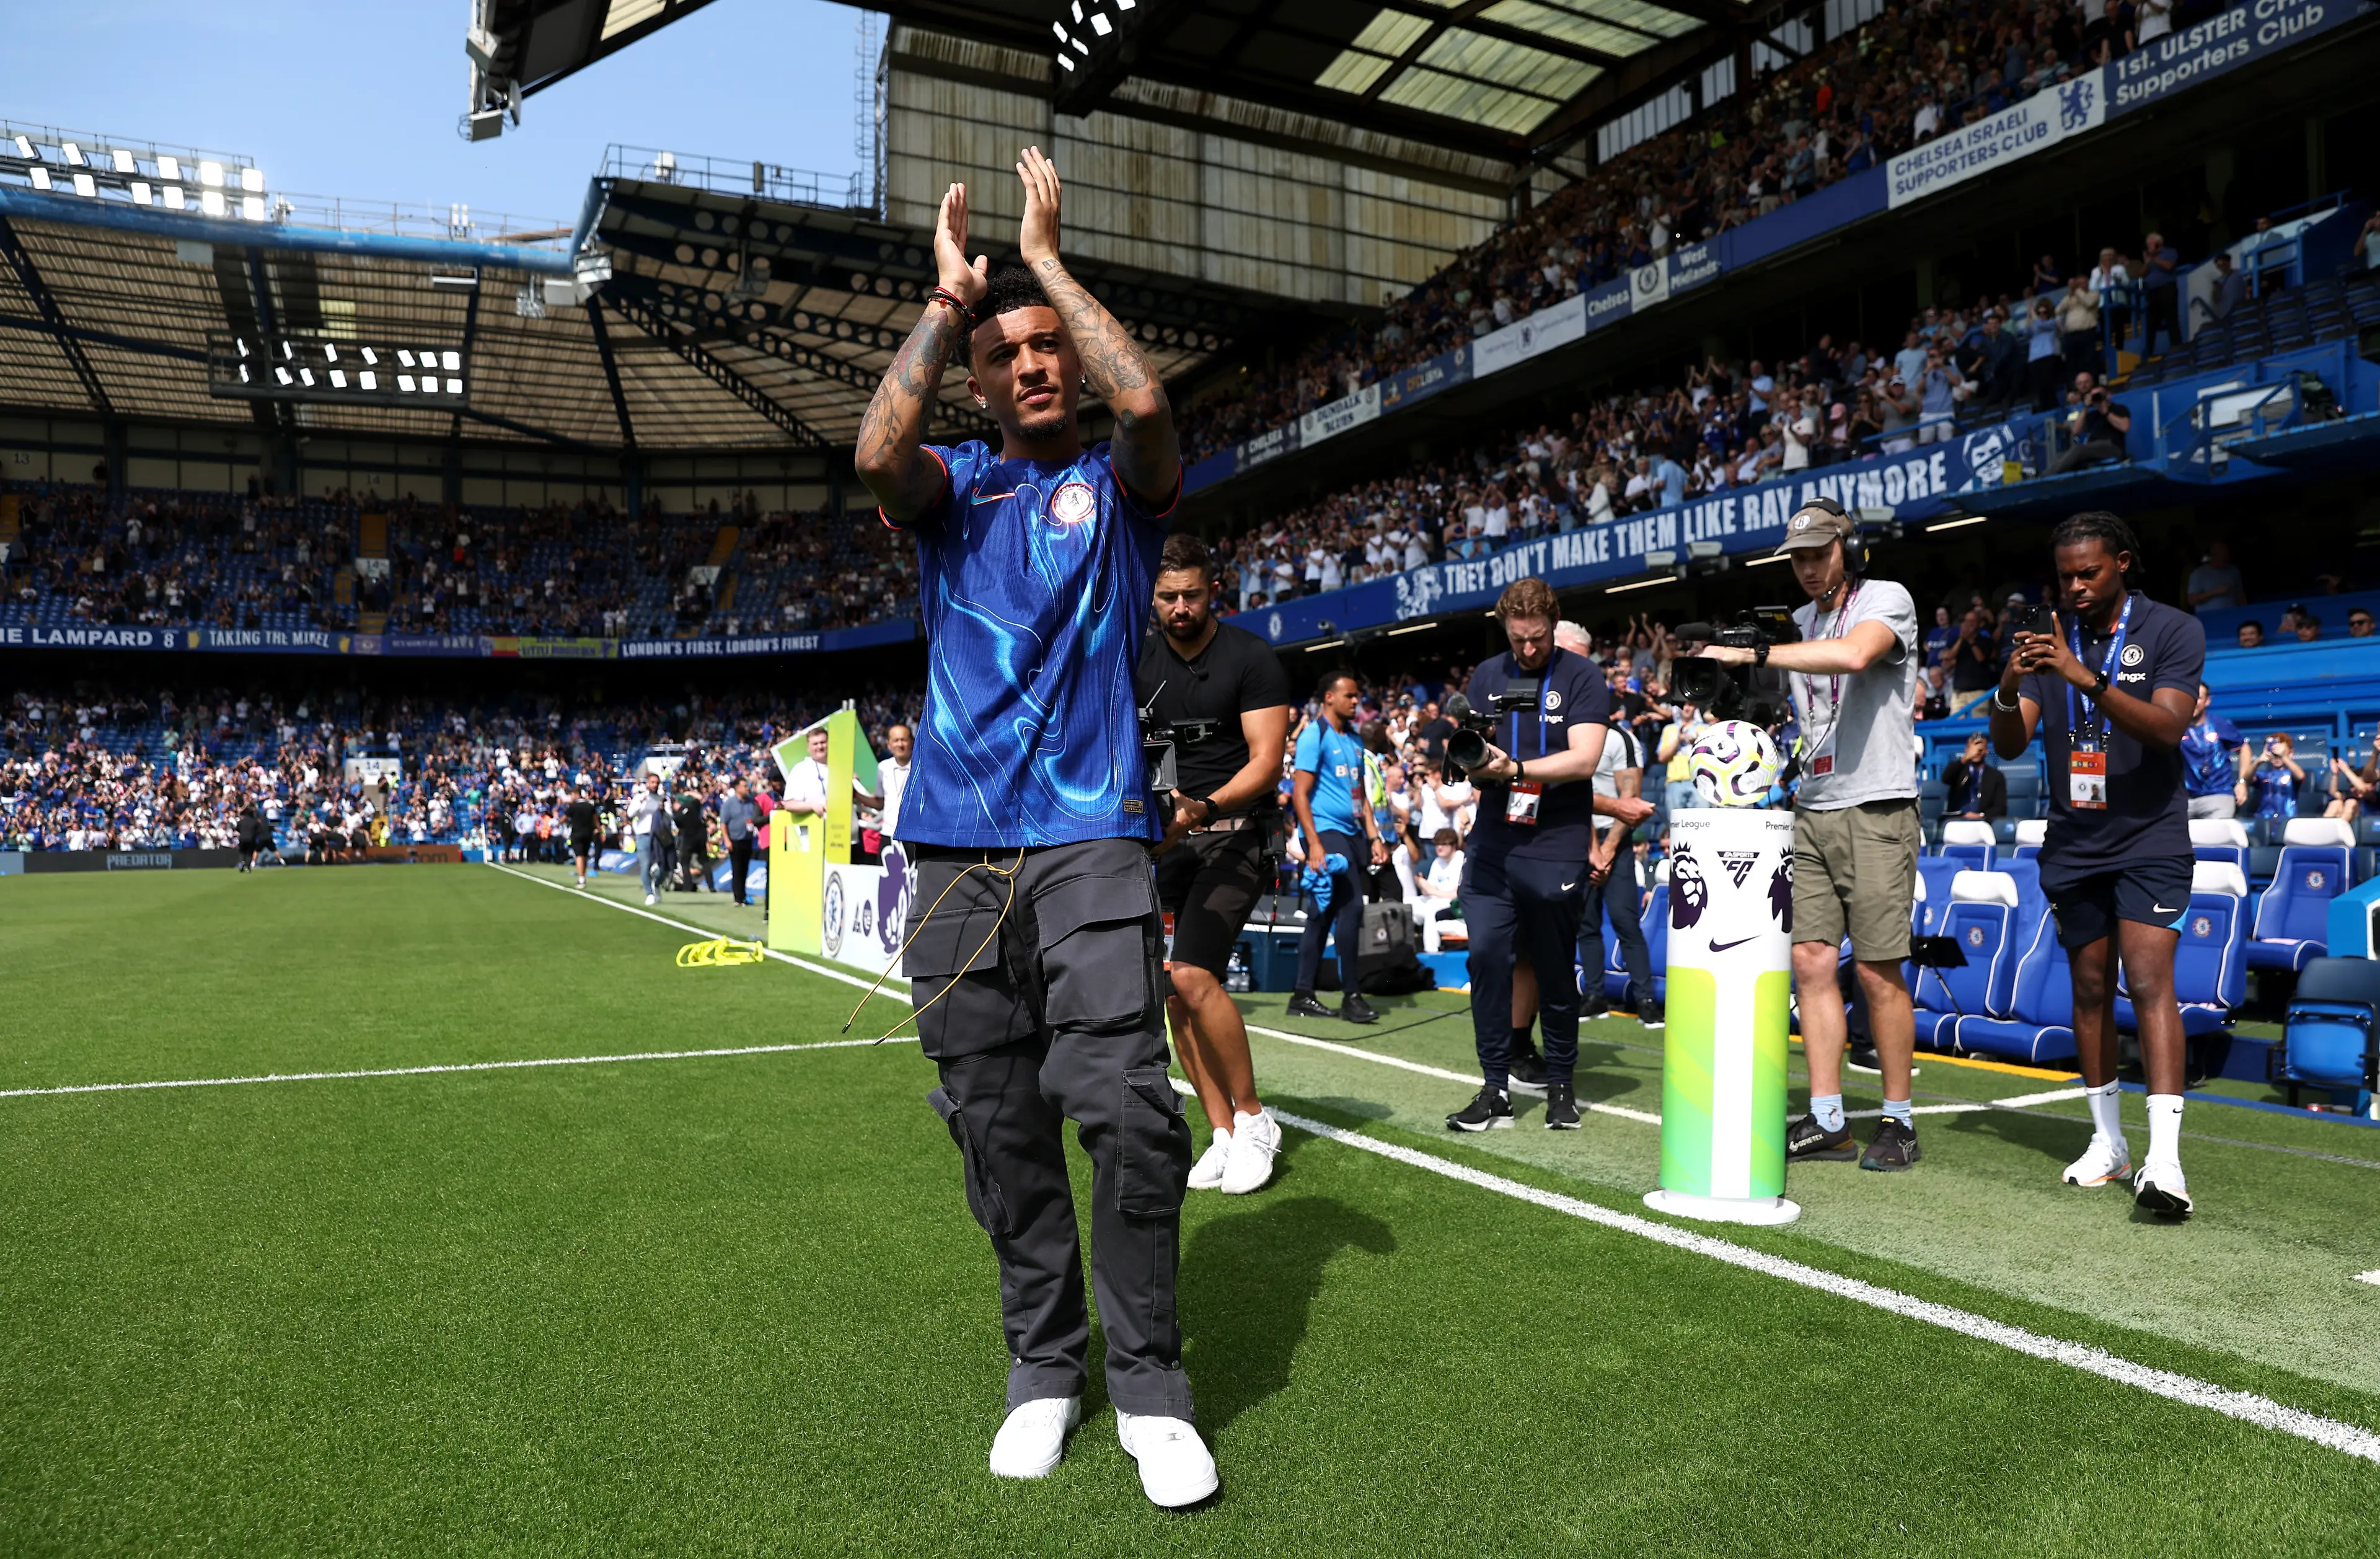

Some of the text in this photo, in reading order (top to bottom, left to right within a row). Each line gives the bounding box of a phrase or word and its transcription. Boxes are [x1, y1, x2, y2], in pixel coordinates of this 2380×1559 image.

[2116, 4, 2324, 106] Supporters Club
[2117, 50, 2156, 80] 1st.
[2161, 8, 2247, 61] ULSTER
[1895, 108, 2028, 176] CHELSEA ISRAELI
[1895, 122, 2048, 195] SUPPORTERS CLUB
[1679, 246, 1708, 267] West
[1588, 289, 1631, 317] Chelsea
[14, 453, 30, 466] 13
[1445, 560, 1487, 595] THEY
[1490, 541, 1547, 588] DON'T
[1552, 528, 1610, 570] MAKE
[1614, 512, 1677, 558] THEM
[1683, 496, 1736, 543] LIKE
[1743, 485, 1793, 532] RAY
[32, 629, 153, 647] LAMPARD
[162, 634, 175, 648] 8
[209, 630, 261, 647] TAKING
[265, 630, 289, 645] THE
[622, 634, 819, 657] LONDON'S FIRST, LONDON'S FINEST
[1681, 819, 1711, 830] League
[1766, 821, 1790, 831] Premier
[107, 854, 172, 871] PREDATOR
